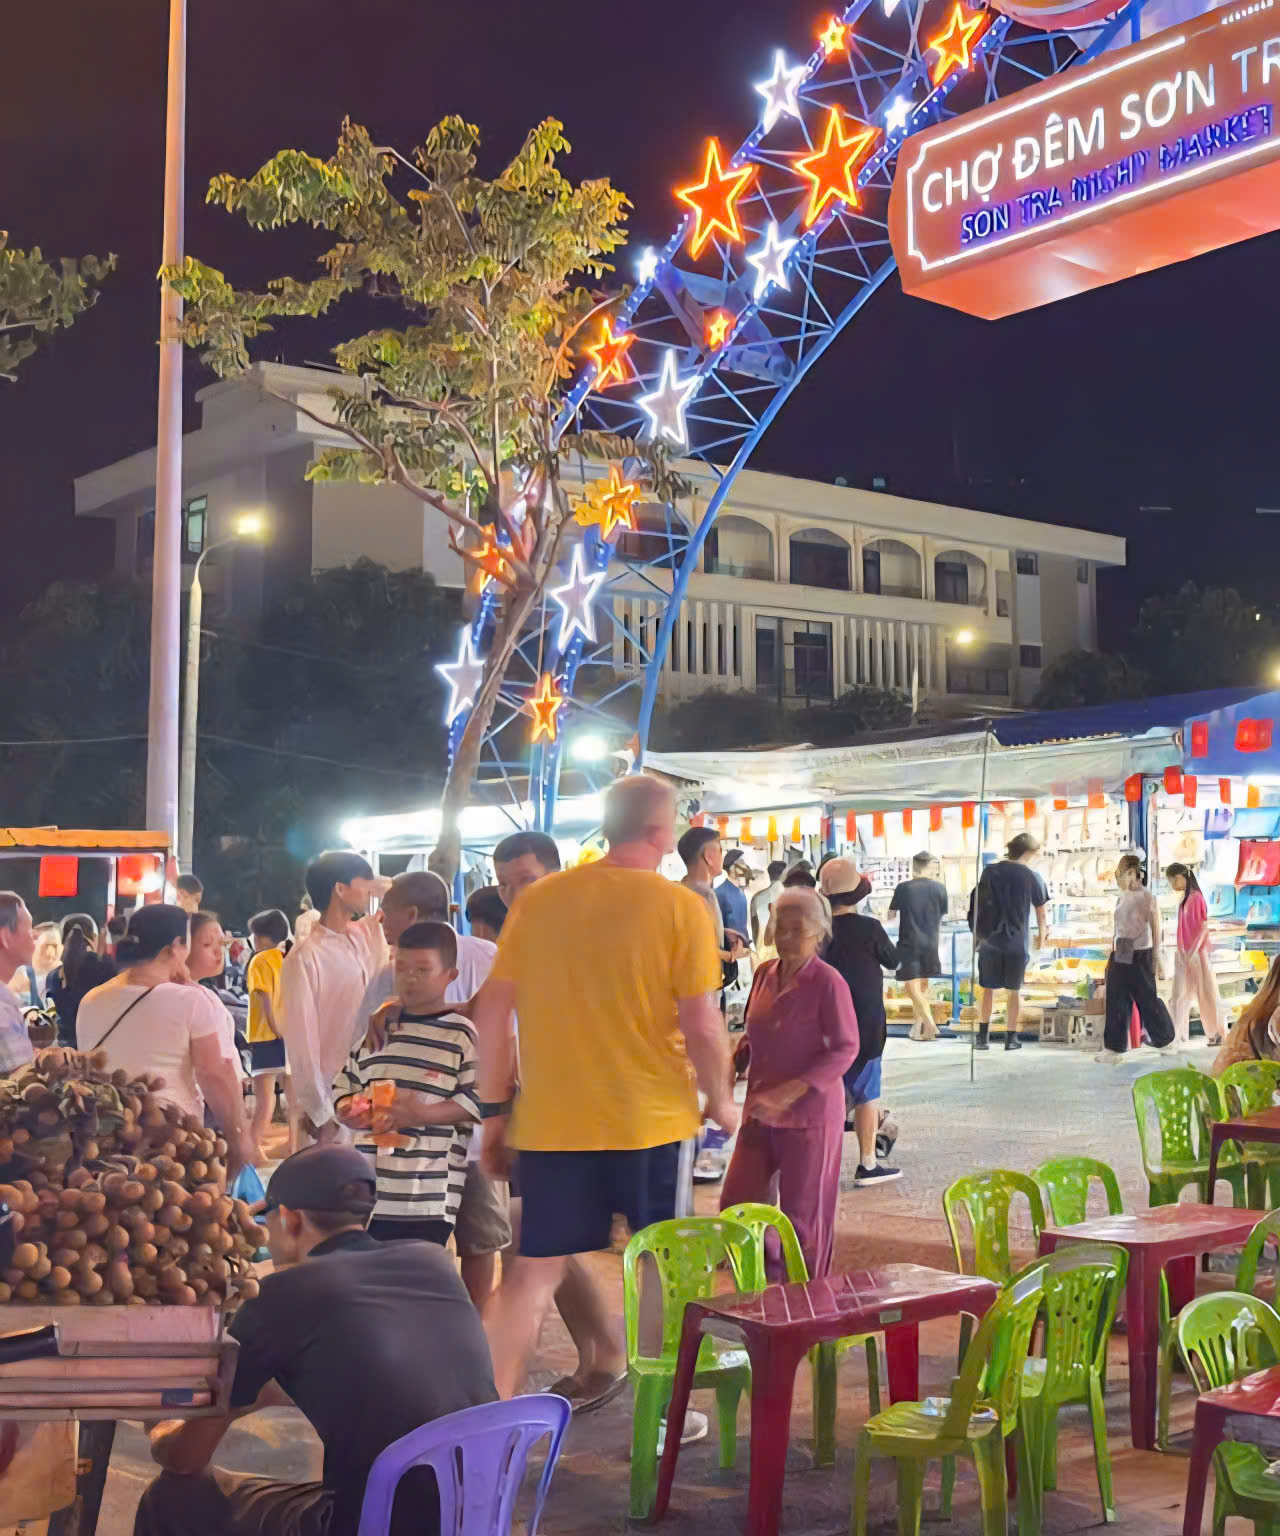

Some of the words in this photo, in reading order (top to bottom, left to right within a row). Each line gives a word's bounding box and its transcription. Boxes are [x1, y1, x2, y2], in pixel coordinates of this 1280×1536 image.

[922, 143, 1002, 213] CHỢ
[1012, 111, 1104, 180] ĐÊM
[1120, 64, 1215, 140] SƠN
[961, 203, 1009, 243] SON
[1016, 186, 1063, 225] TRA
[1159, 105, 1272, 172] MARKET
